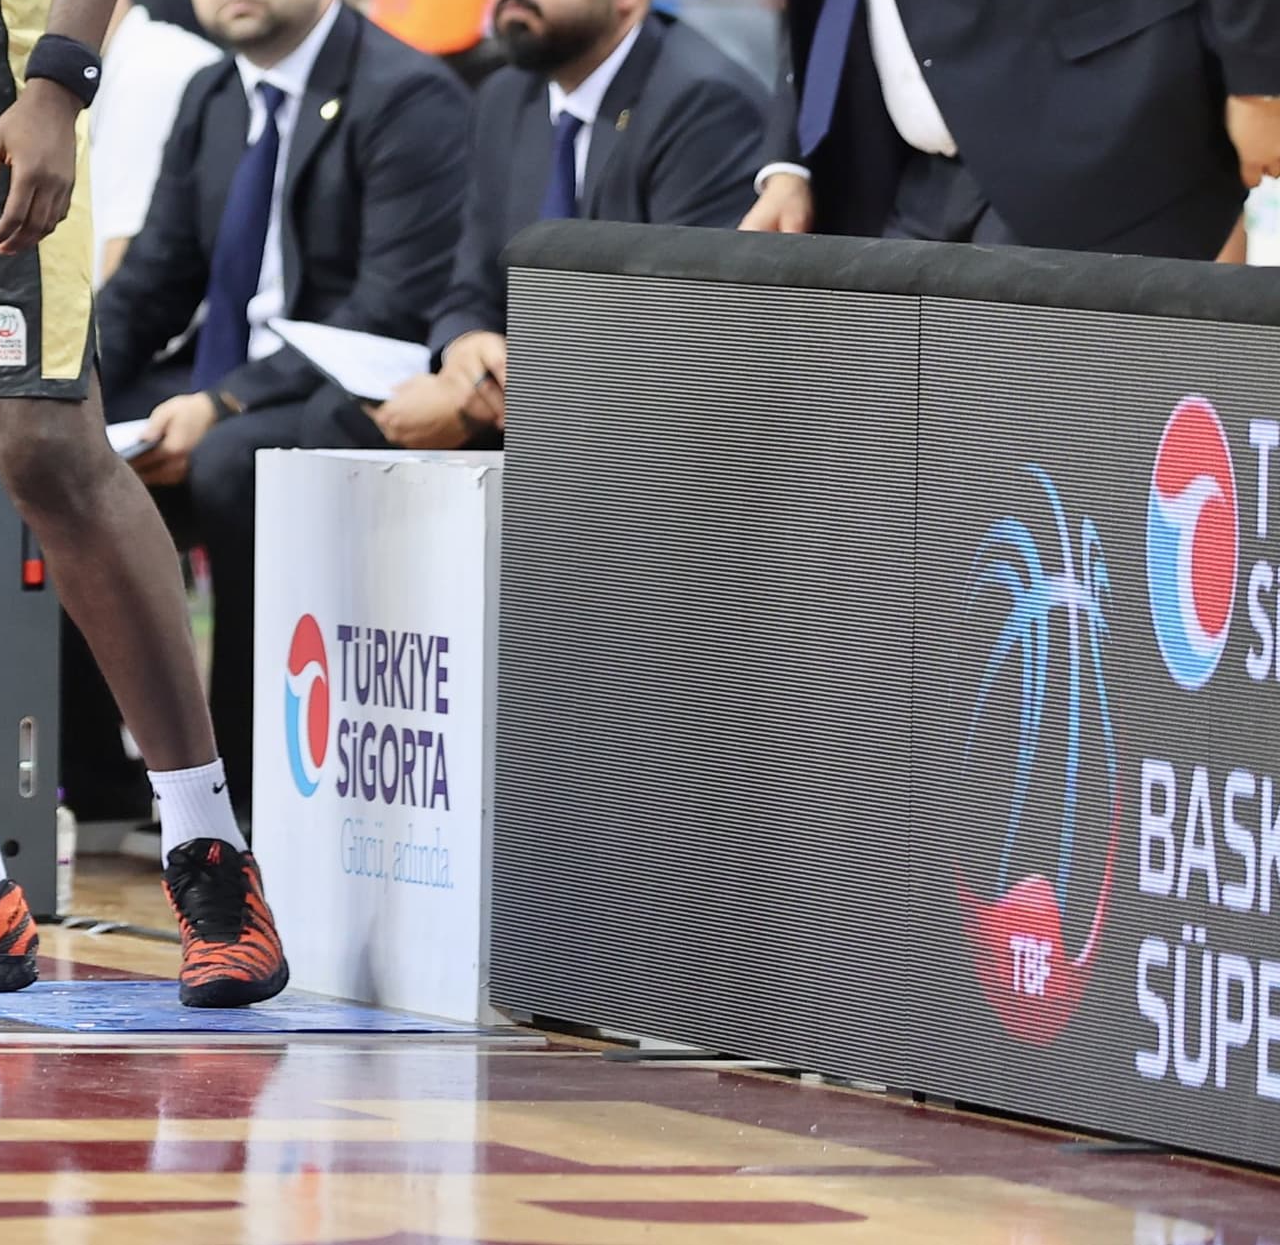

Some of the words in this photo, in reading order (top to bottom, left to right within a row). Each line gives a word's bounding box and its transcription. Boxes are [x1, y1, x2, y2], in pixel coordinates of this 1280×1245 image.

[337, 624, 449, 714] TÜRKİYE
[336, 717, 450, 811] SİGORTA
[1010, 933, 1052, 996] TBF
